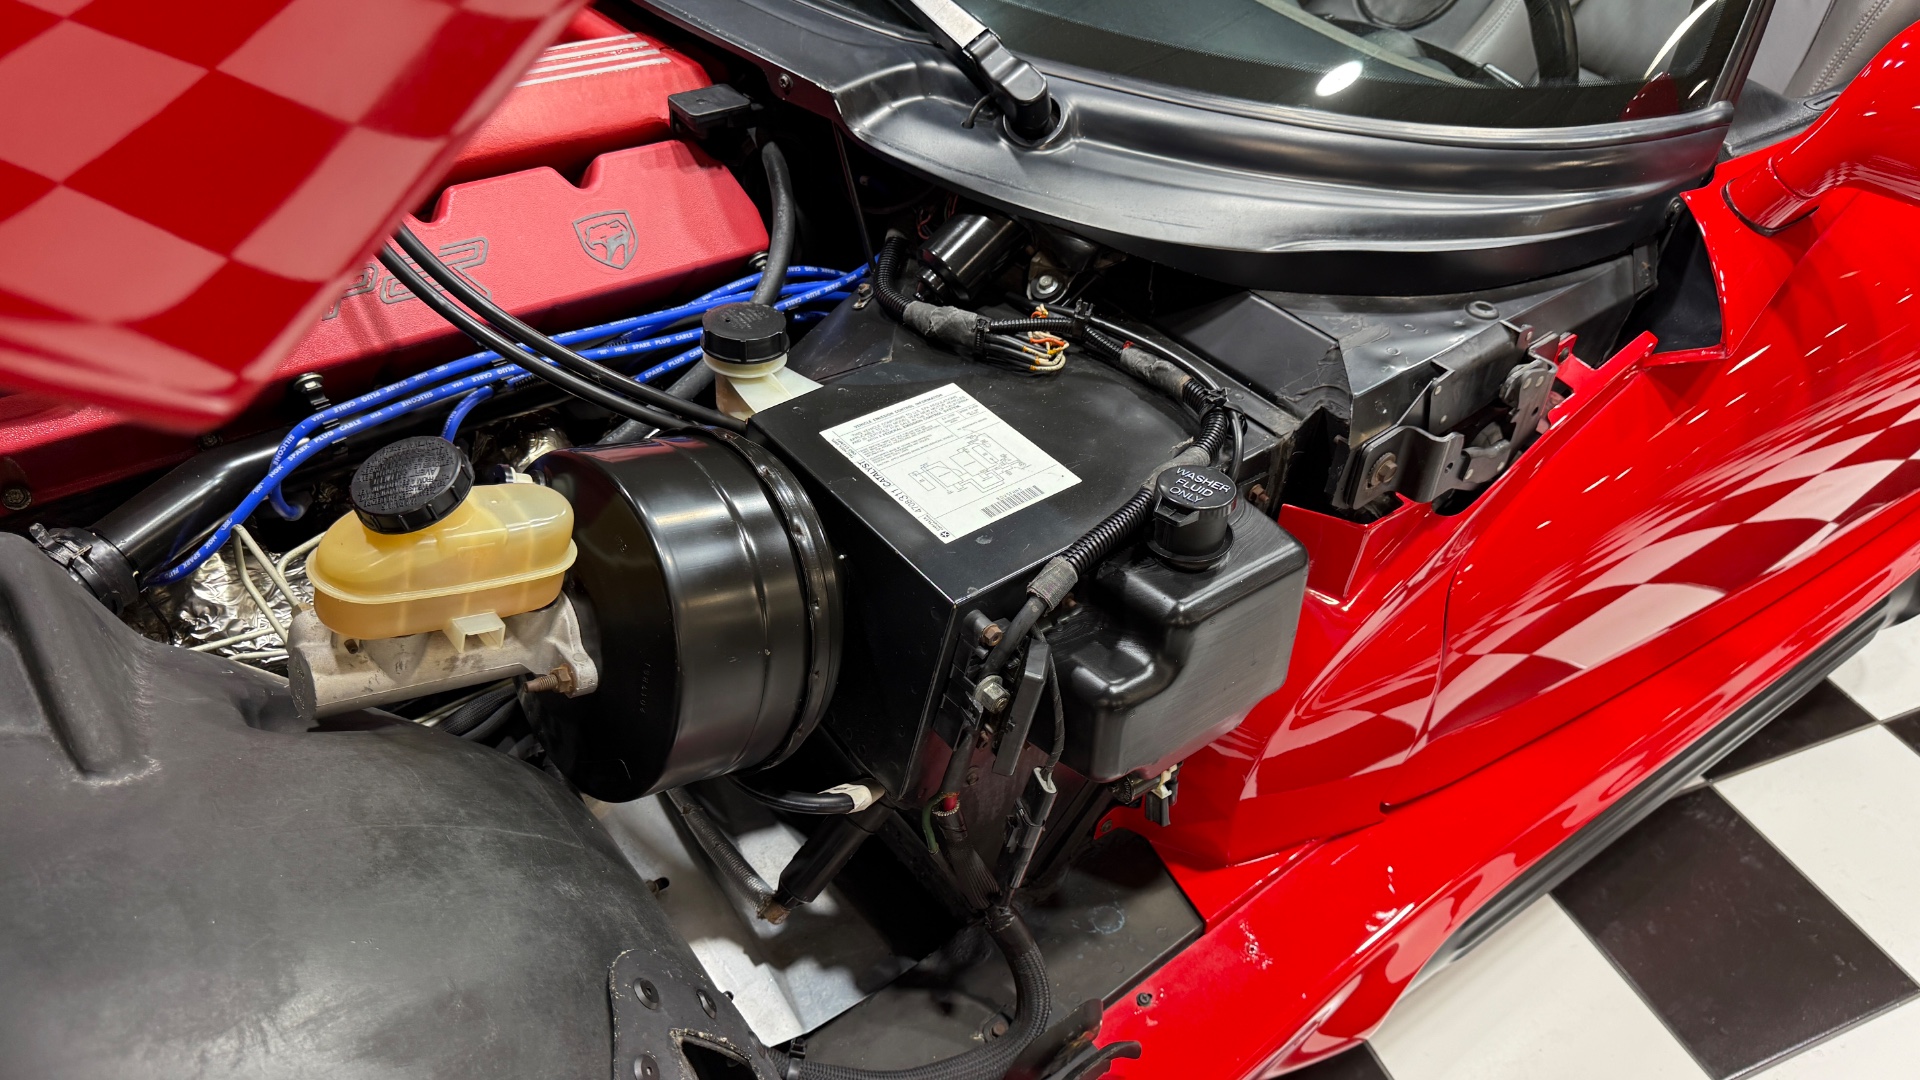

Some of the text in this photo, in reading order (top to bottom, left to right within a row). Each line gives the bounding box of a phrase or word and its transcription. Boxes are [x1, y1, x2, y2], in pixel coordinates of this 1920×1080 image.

[824, 282, 841, 292] SPARK
[805, 291, 820, 299] PLUG
[784, 298, 801, 307] CABLE
[632, 342, 651, 350] SPARK
[497, 365, 515, 375] PLUG
[644, 367, 664, 379] SPARK
[668, 357, 684, 367] PLUG
[471, 372, 492, 382] CABLE
[385, 381, 408, 393] SPARK
[361, 391, 380, 402] PLUG
[401, 392, 434, 407] SILICONE
[333, 402, 356, 413] CABLE
[287, 444, 310, 462] SPARK
[313, 431, 334, 443] PLUG
[339, 419, 362, 431] CABLE
[273, 434, 295, 465] SILICONE
[856, 459, 892, 487] CATALYST
[1176, 468, 1231, 493] WASHER
[1176, 478, 1214, 497] FLUID
[1169, 486, 1204, 503] ONLY
[182, 551, 201, 569] SPARK
